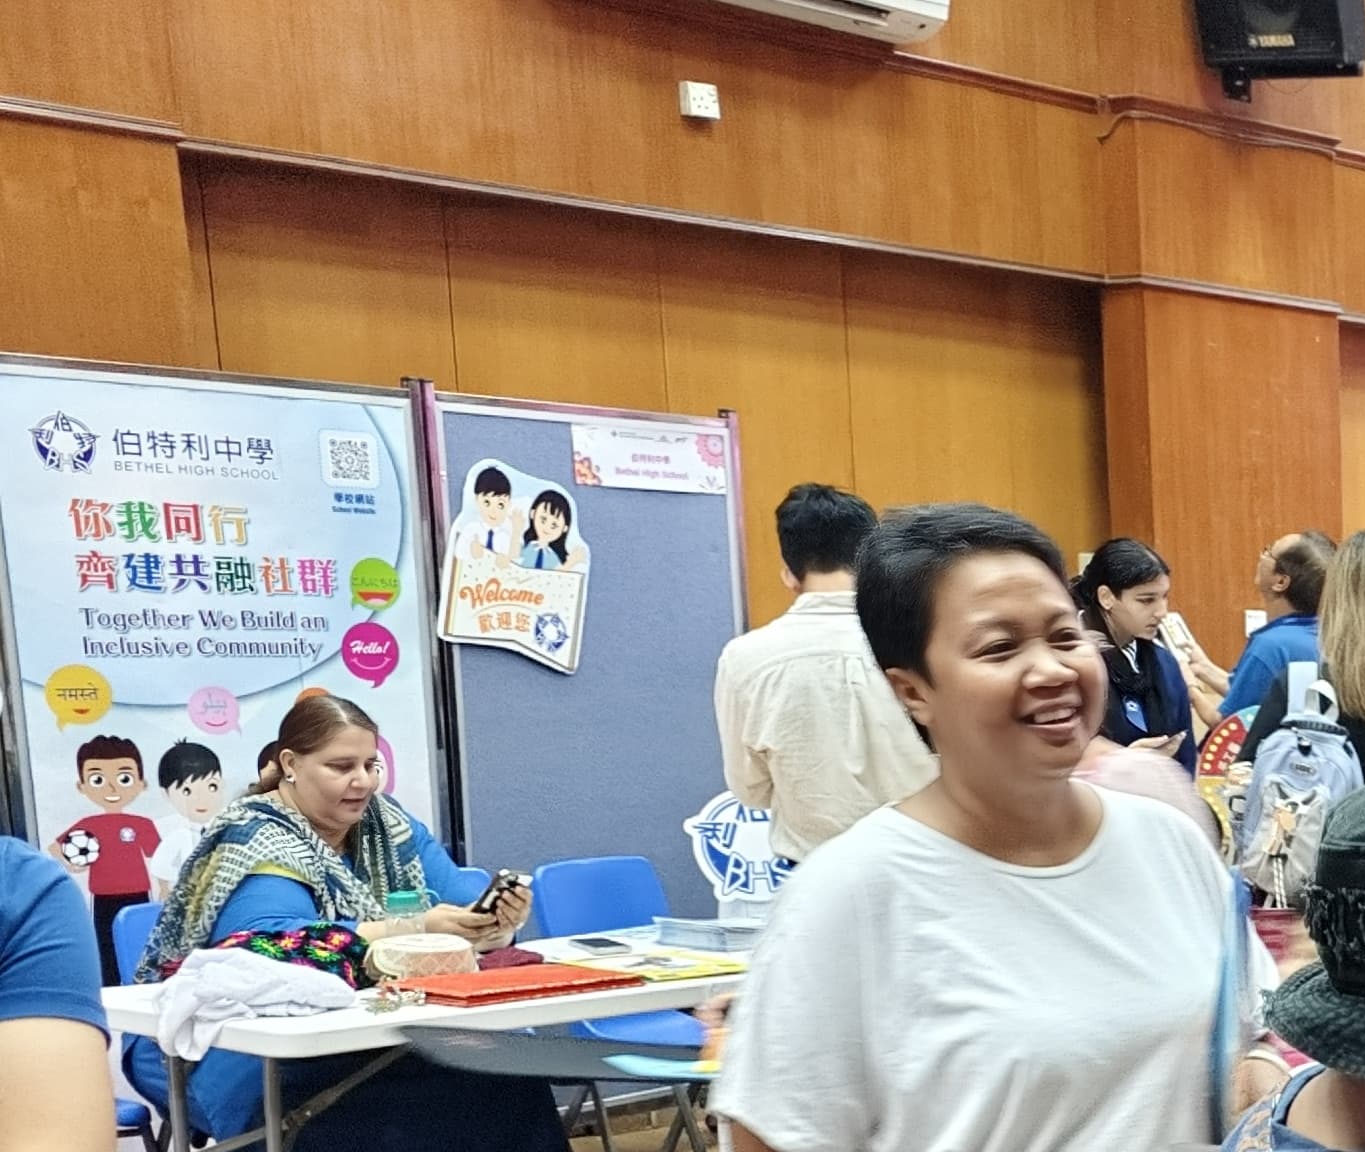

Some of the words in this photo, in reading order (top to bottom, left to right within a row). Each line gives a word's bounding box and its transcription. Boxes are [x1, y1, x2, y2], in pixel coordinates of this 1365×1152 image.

[112, 428, 275, 465] 伯特利中學
[114, 461, 173, 475] BETHEL
[178, 464, 216, 477] HIGH
[220, 466, 280, 481] SCHOOL
[68, 497, 249, 546] 你我同行
[75, 550, 338, 598] 齊建共融社群
[459, 577, 545, 609] Welcome
[80, 608, 192, 632] Together
[198, 609, 238, 630] We
[241, 610, 296, 631] Build
[300, 616, 328, 631] an
[83, 636, 190, 657] Inclusive
[196, 637, 324, 661] Community
[349, 639, 389, 655] Hello!
